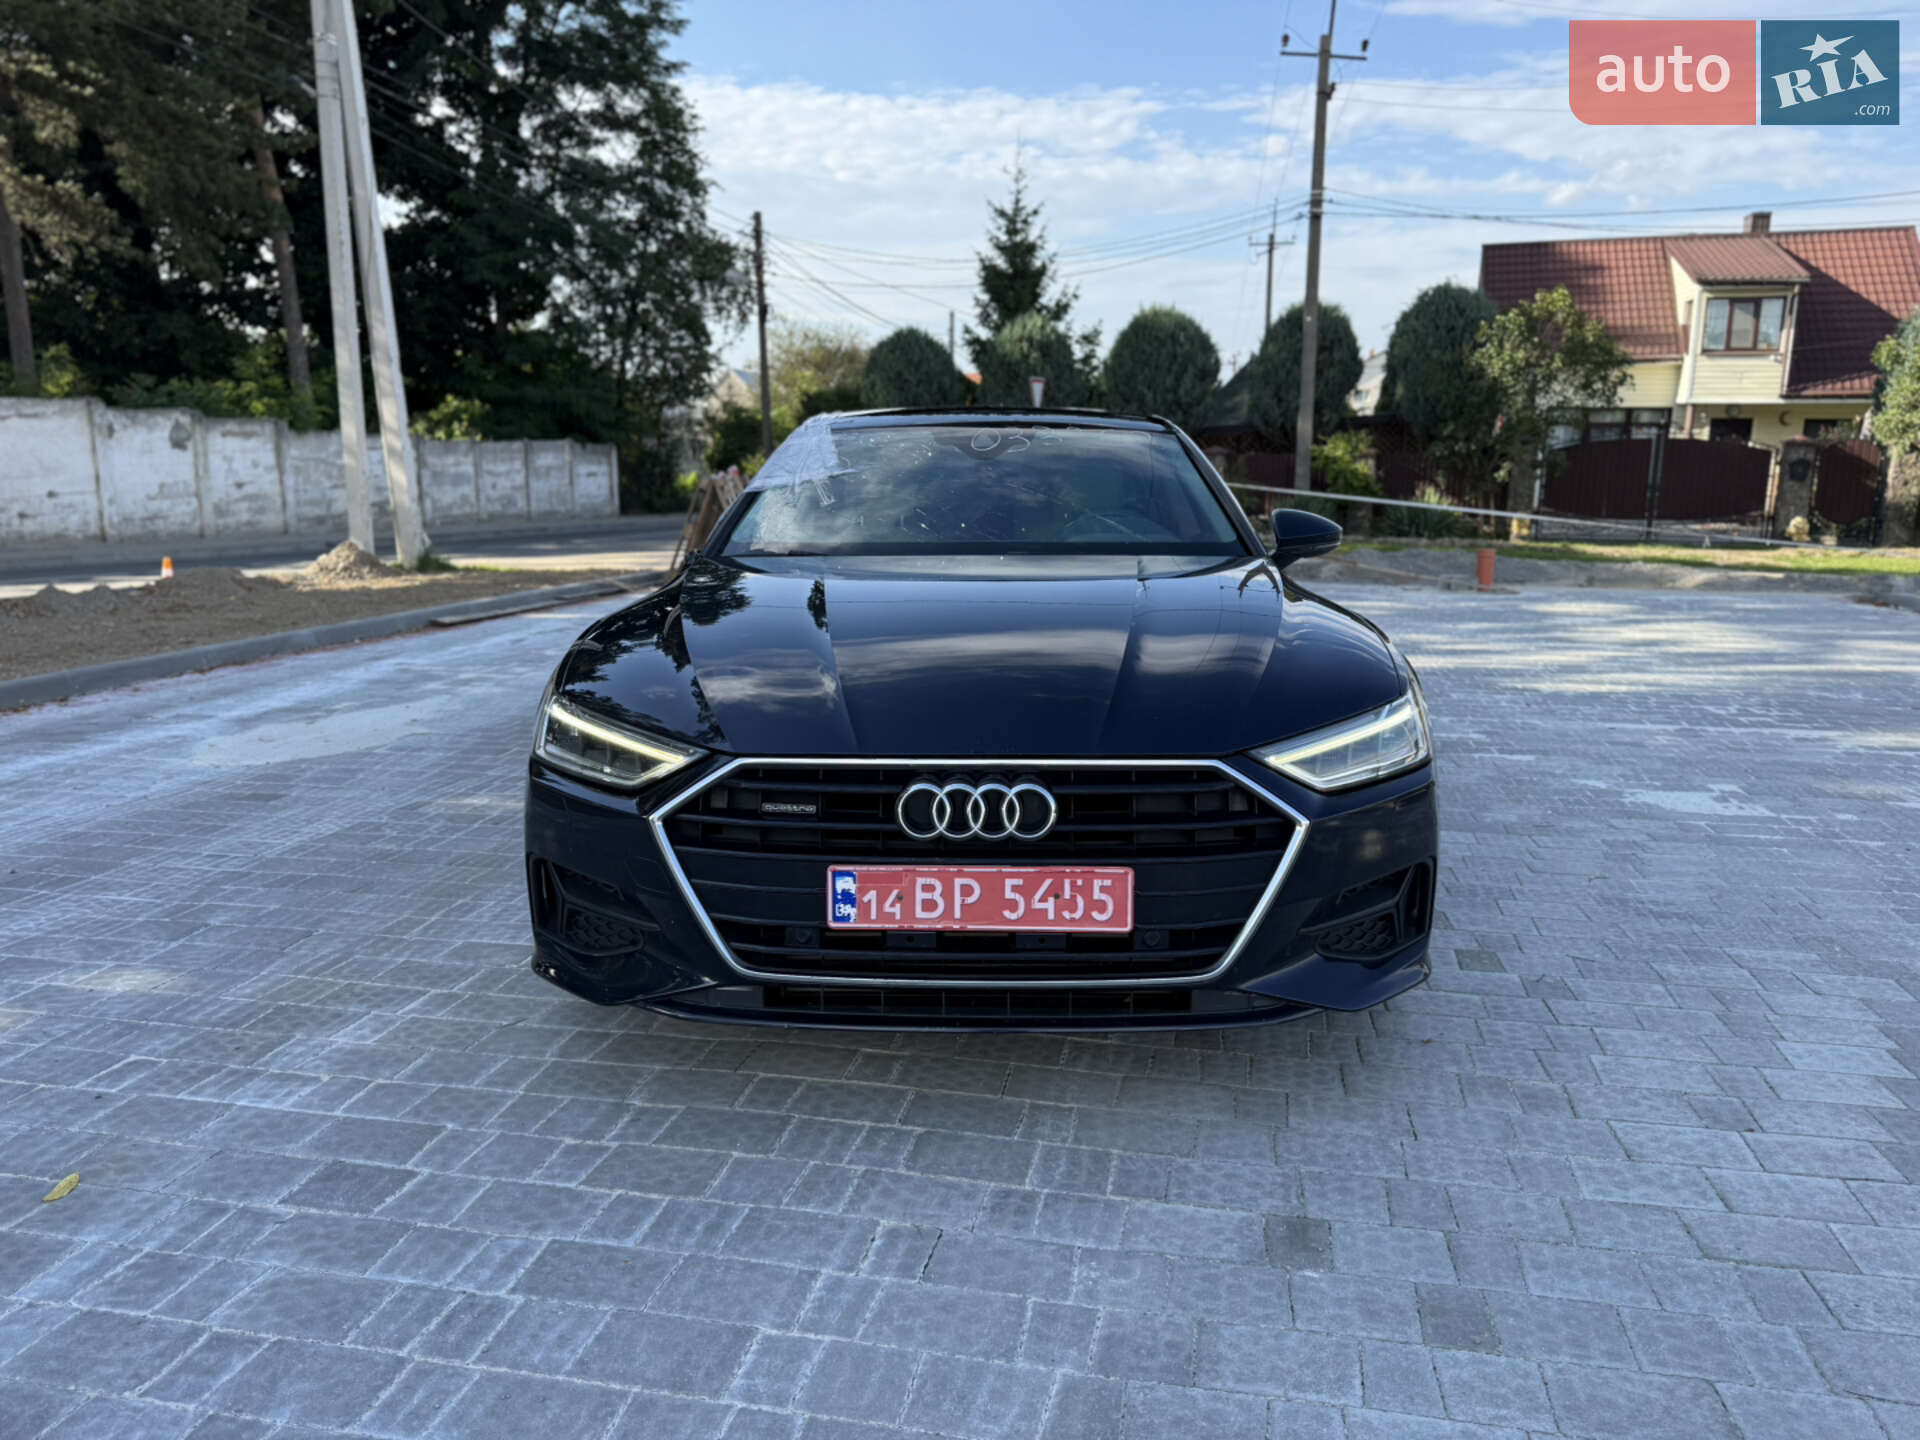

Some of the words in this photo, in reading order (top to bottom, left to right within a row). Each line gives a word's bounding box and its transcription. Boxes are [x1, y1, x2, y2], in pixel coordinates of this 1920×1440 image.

[862, 889, 901, 920] 14
[915, 877, 981, 919] BP
[1002, 878, 1115, 921] 5455
